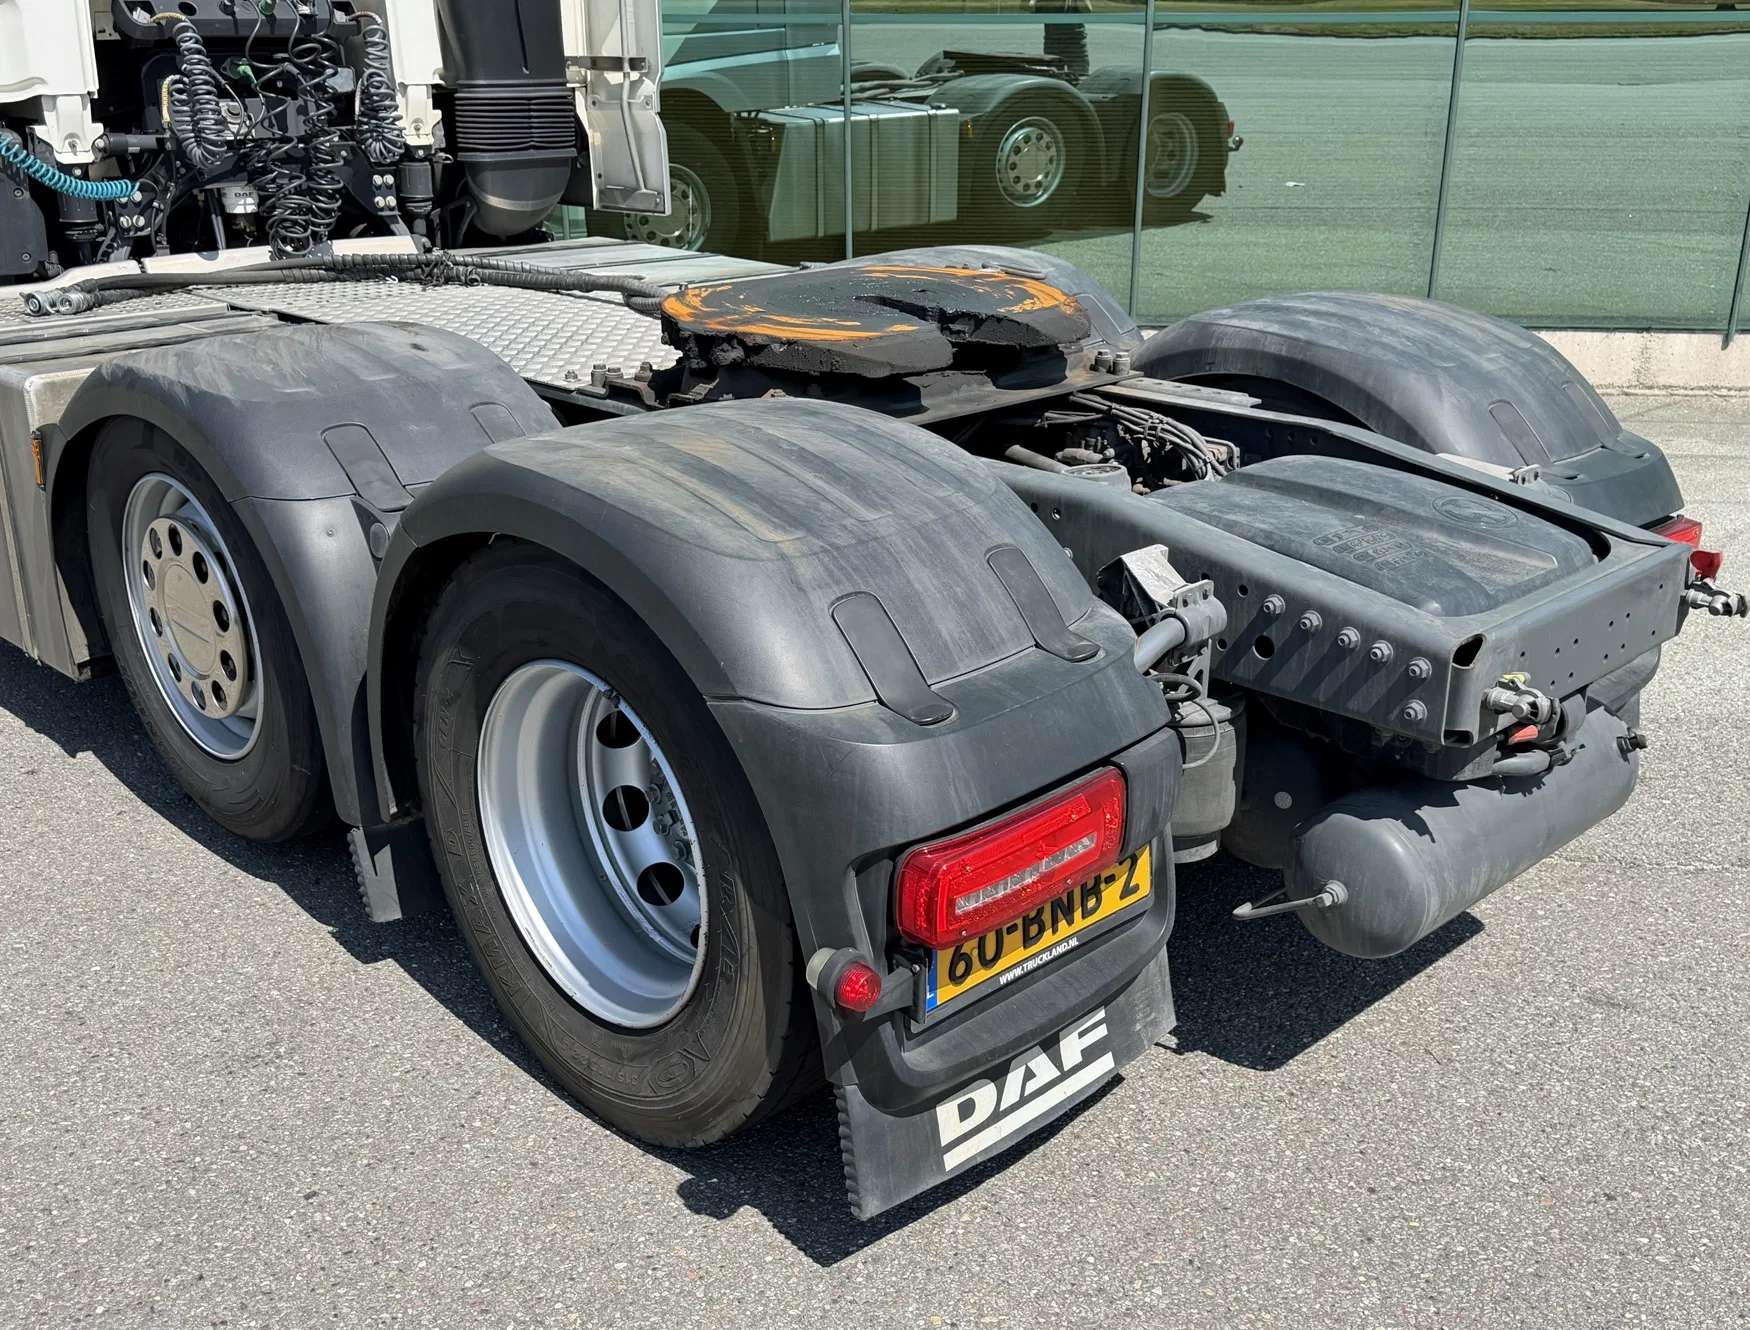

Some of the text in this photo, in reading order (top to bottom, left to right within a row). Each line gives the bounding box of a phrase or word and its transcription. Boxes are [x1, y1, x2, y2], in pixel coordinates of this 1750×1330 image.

[948, 852, 1140, 987] 60-BNB-2
[999, 937, 1079, 985] WWW.TRUCKLAND.NL
[935, 1005, 1108, 1147] DAF
